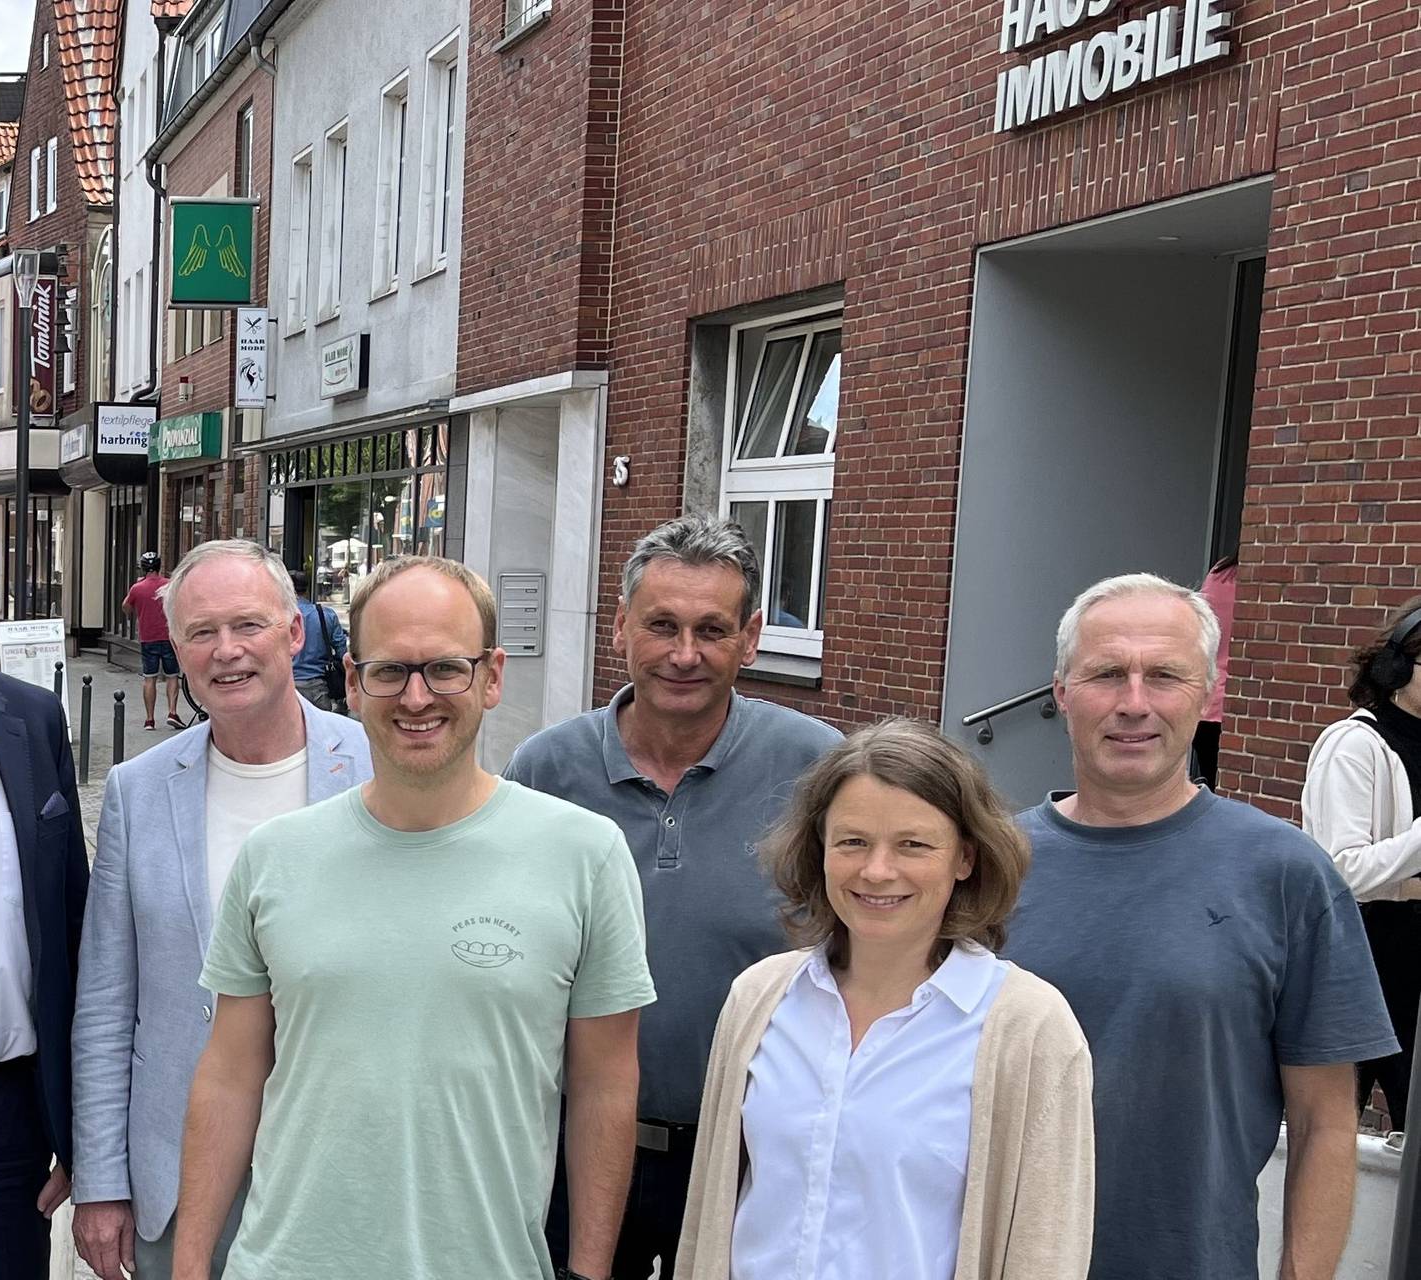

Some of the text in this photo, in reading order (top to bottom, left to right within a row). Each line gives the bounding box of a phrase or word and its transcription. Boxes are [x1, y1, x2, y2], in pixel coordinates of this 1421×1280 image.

[1000, 0, 1115, 54] HA
[993, 0, 1230, 134] IMMOBILIE
[31, 282, 52, 378] Tombrink
[100, 413, 155, 429] textilpflege
[100, 434, 149, 449] harbring
[451, 916, 522, 937] PEAS ON HEART
